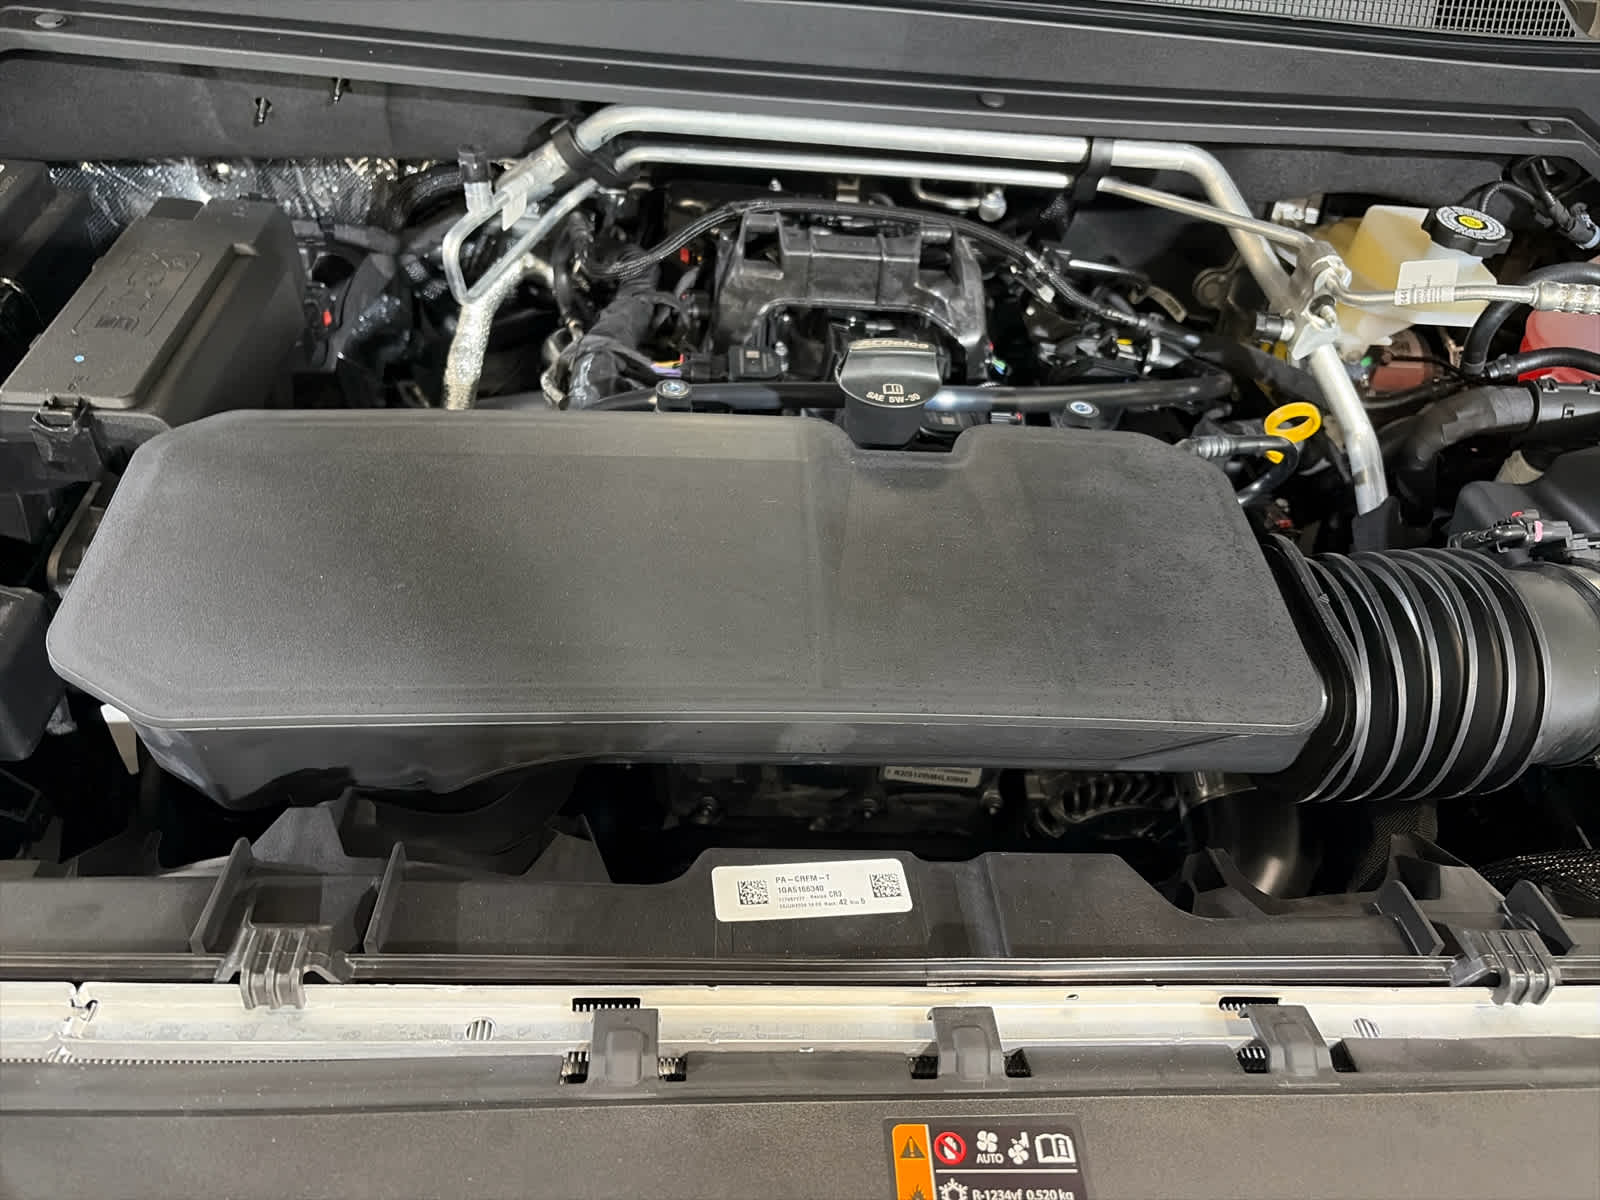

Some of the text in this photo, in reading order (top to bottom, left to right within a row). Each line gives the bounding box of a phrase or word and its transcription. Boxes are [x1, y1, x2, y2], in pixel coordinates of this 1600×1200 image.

[865, 391, 921, 403] SAE 5W-30
[976, 1153, 1004, 1165] AUTO
